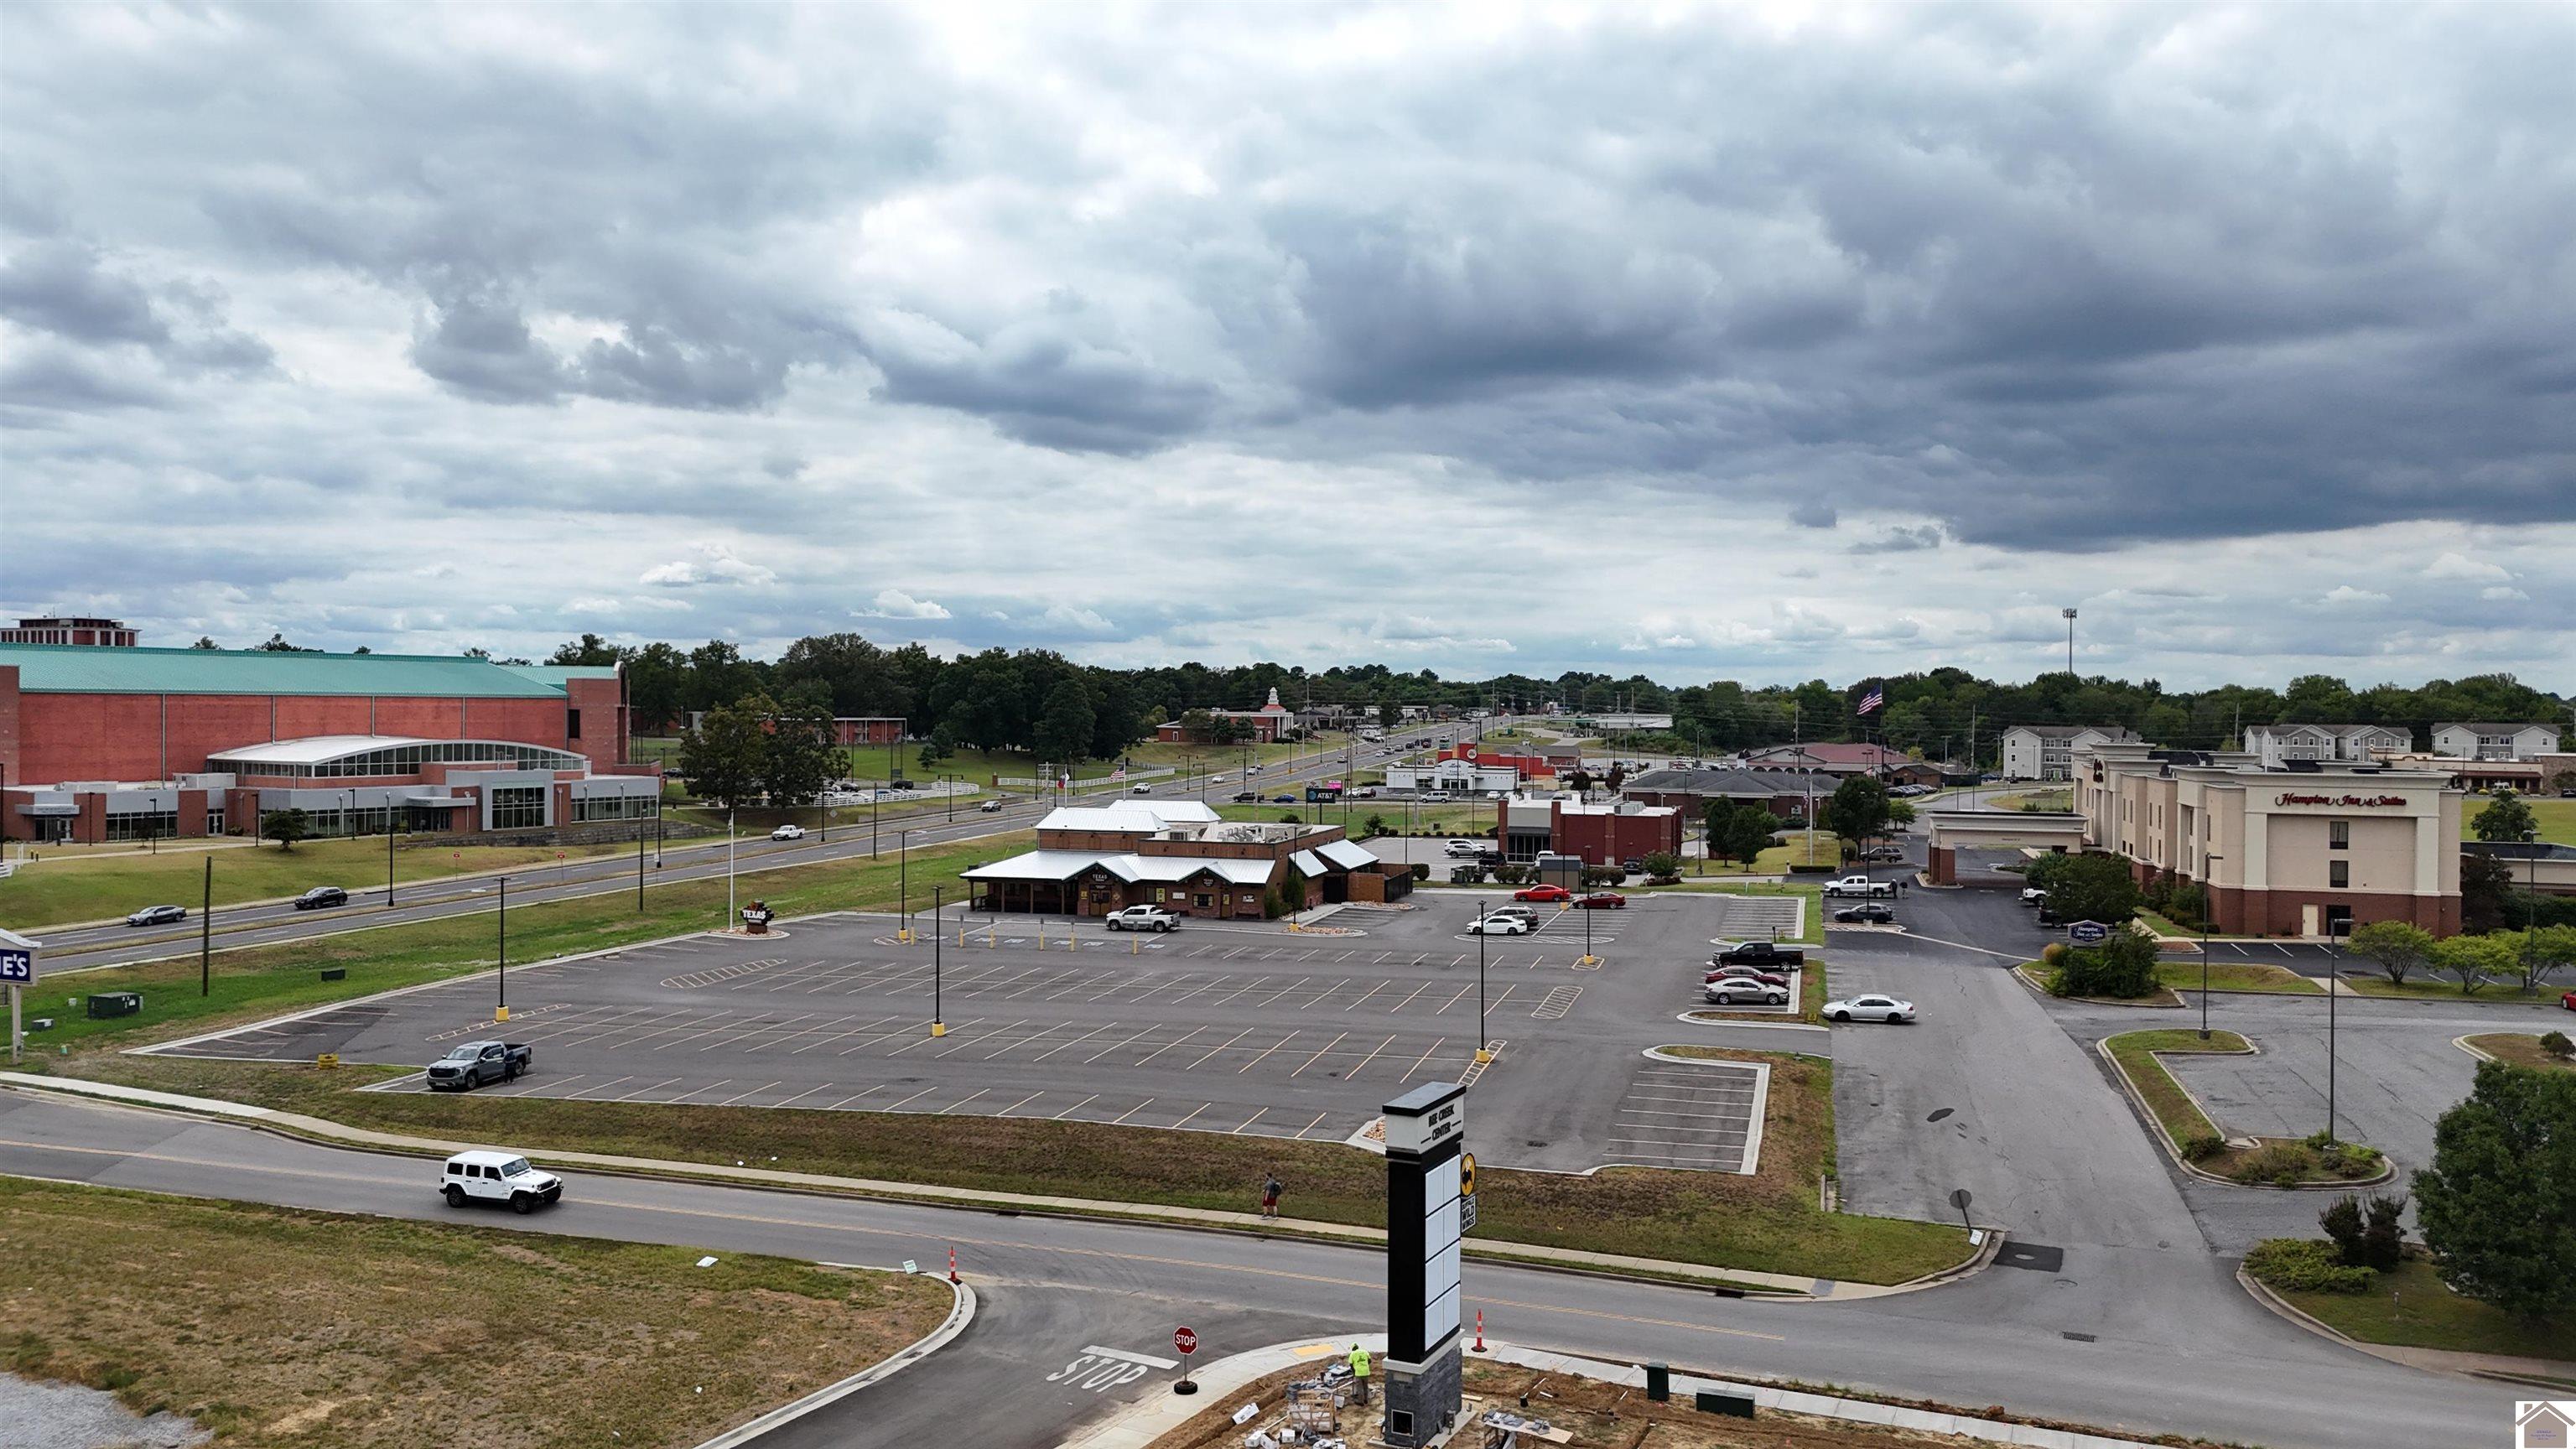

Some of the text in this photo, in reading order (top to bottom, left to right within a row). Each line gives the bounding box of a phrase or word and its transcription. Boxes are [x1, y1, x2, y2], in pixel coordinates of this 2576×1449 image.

[2275, 792, 2335, 806] Hampton
[2336, 795, 2366, 807] Inn
[2374, 795, 2407, 807] Suites
[743, 910, 766, 919] TEXAS
[0, 954, 27, 976] E'S
[1428, 1104, 1455, 1127] BEE CREEK
[1432, 1122, 1452, 1141] CENTER
[1462, 1204, 1475, 1222] WILD
[1462, 1216, 1475, 1230] WINGS
[1176, 1334, 1196, 1347] STOP
[1046, 1355, 1148, 1393] STOP
